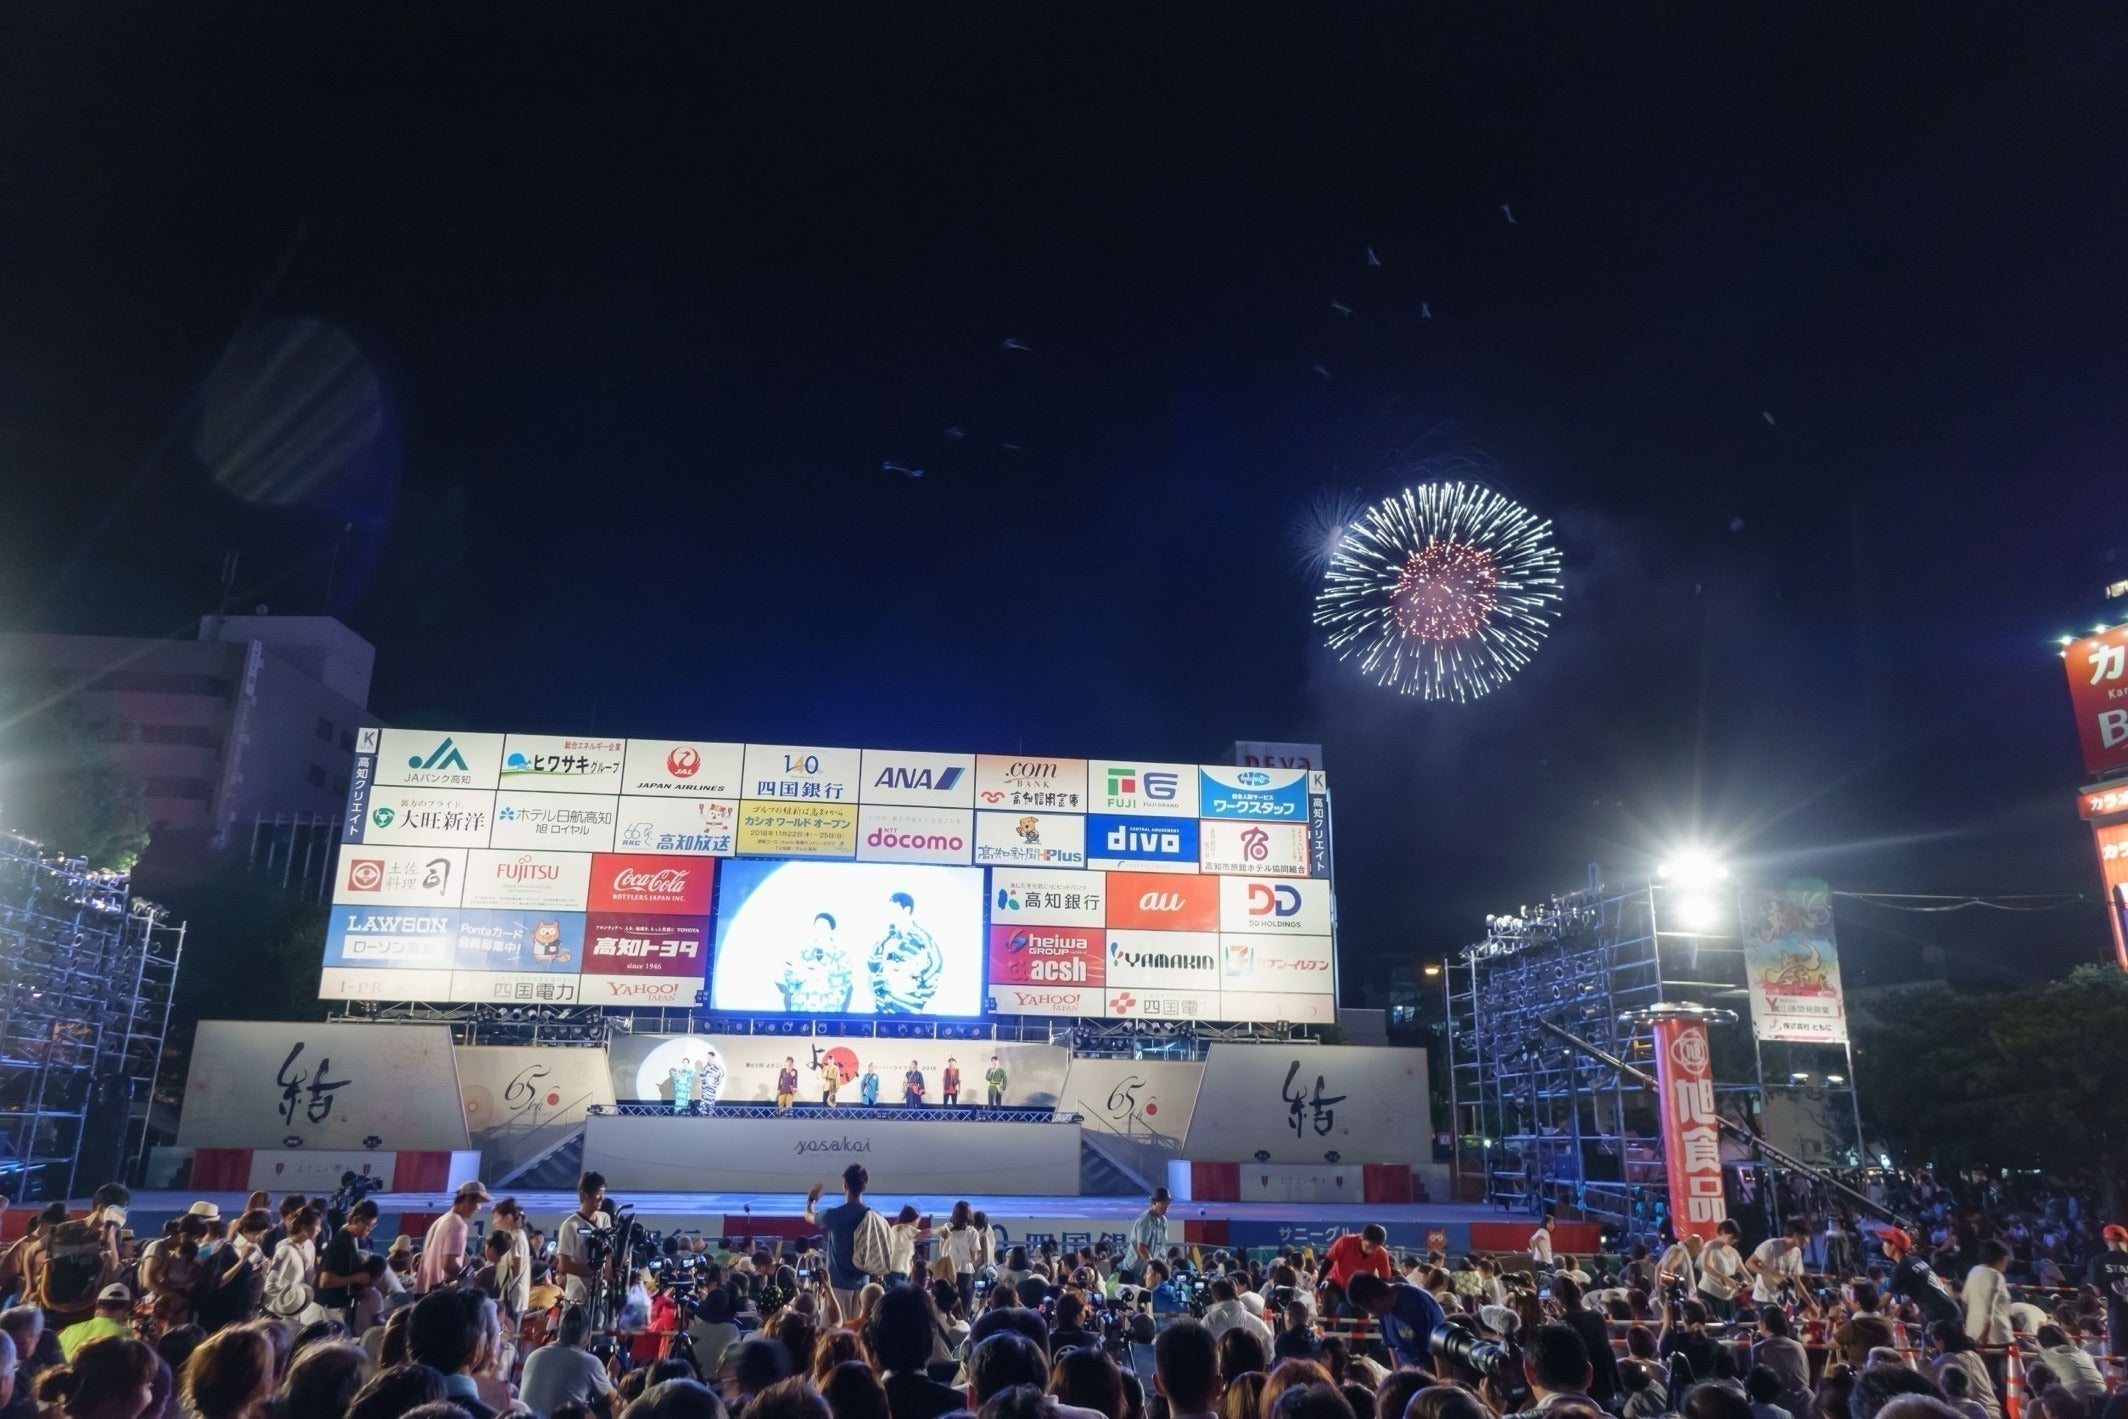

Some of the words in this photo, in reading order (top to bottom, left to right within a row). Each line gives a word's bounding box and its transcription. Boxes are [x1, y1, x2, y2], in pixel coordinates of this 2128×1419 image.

[363, 731, 377, 746] K
[404, 773, 471, 785] JAバンク高知
[636, 782, 673, 791] JAPAN
[675, 783, 726, 792] AIRLINES
[874, 767, 932, 790] ANA
[1017, 779, 1051, 789] BANK
[1313, 773, 1323, 788] K
[349, 757, 371, 836] 高知クリエイト
[757, 780, 844, 800] 四国銀行
[1010, 791, 1080, 808] 高知信用金庫
[1107, 798, 1137, 809] FUJI
[1213, 799, 1296, 816] ワークスタッフ
[398, 809, 485, 832] 大旺新洋
[516, 807, 612, 825] ホテル日航高知
[656, 833, 732, 852] 高知放送
[867, 828, 964, 851] docomo
[1312, 797, 1327, 873] 高知クリエイト
[496, 865, 560, 886] FUJITSU
[612, 893, 649, 902] BOTTLERS
[649, 894, 670, 903] JAPAN
[1025, 891, 1101, 911] 高知銀行
[1139, 892, 1187, 912] au
[346, 915, 449, 934] LAWSON
[1261, 920, 1301, 929] HOLDINGS
[592, 937, 699, 958] 高知トヨタ
[1028, 933, 1088, 949] heiwa
[1028, 948, 1070, 956] GROUP
[1124, 953, 1215, 970] YAMAKIN
[494, 981, 575, 1001] 四国電力
[607, 982, 679, 997] YAHOO!
[648, 993, 675, 1003] JAPAN
[1013, 991, 1080, 1006] YAHOO!
[1053, 1004, 1078, 1012] JAPAN
[1675, 1077, 1727, 1224] 旭食品
